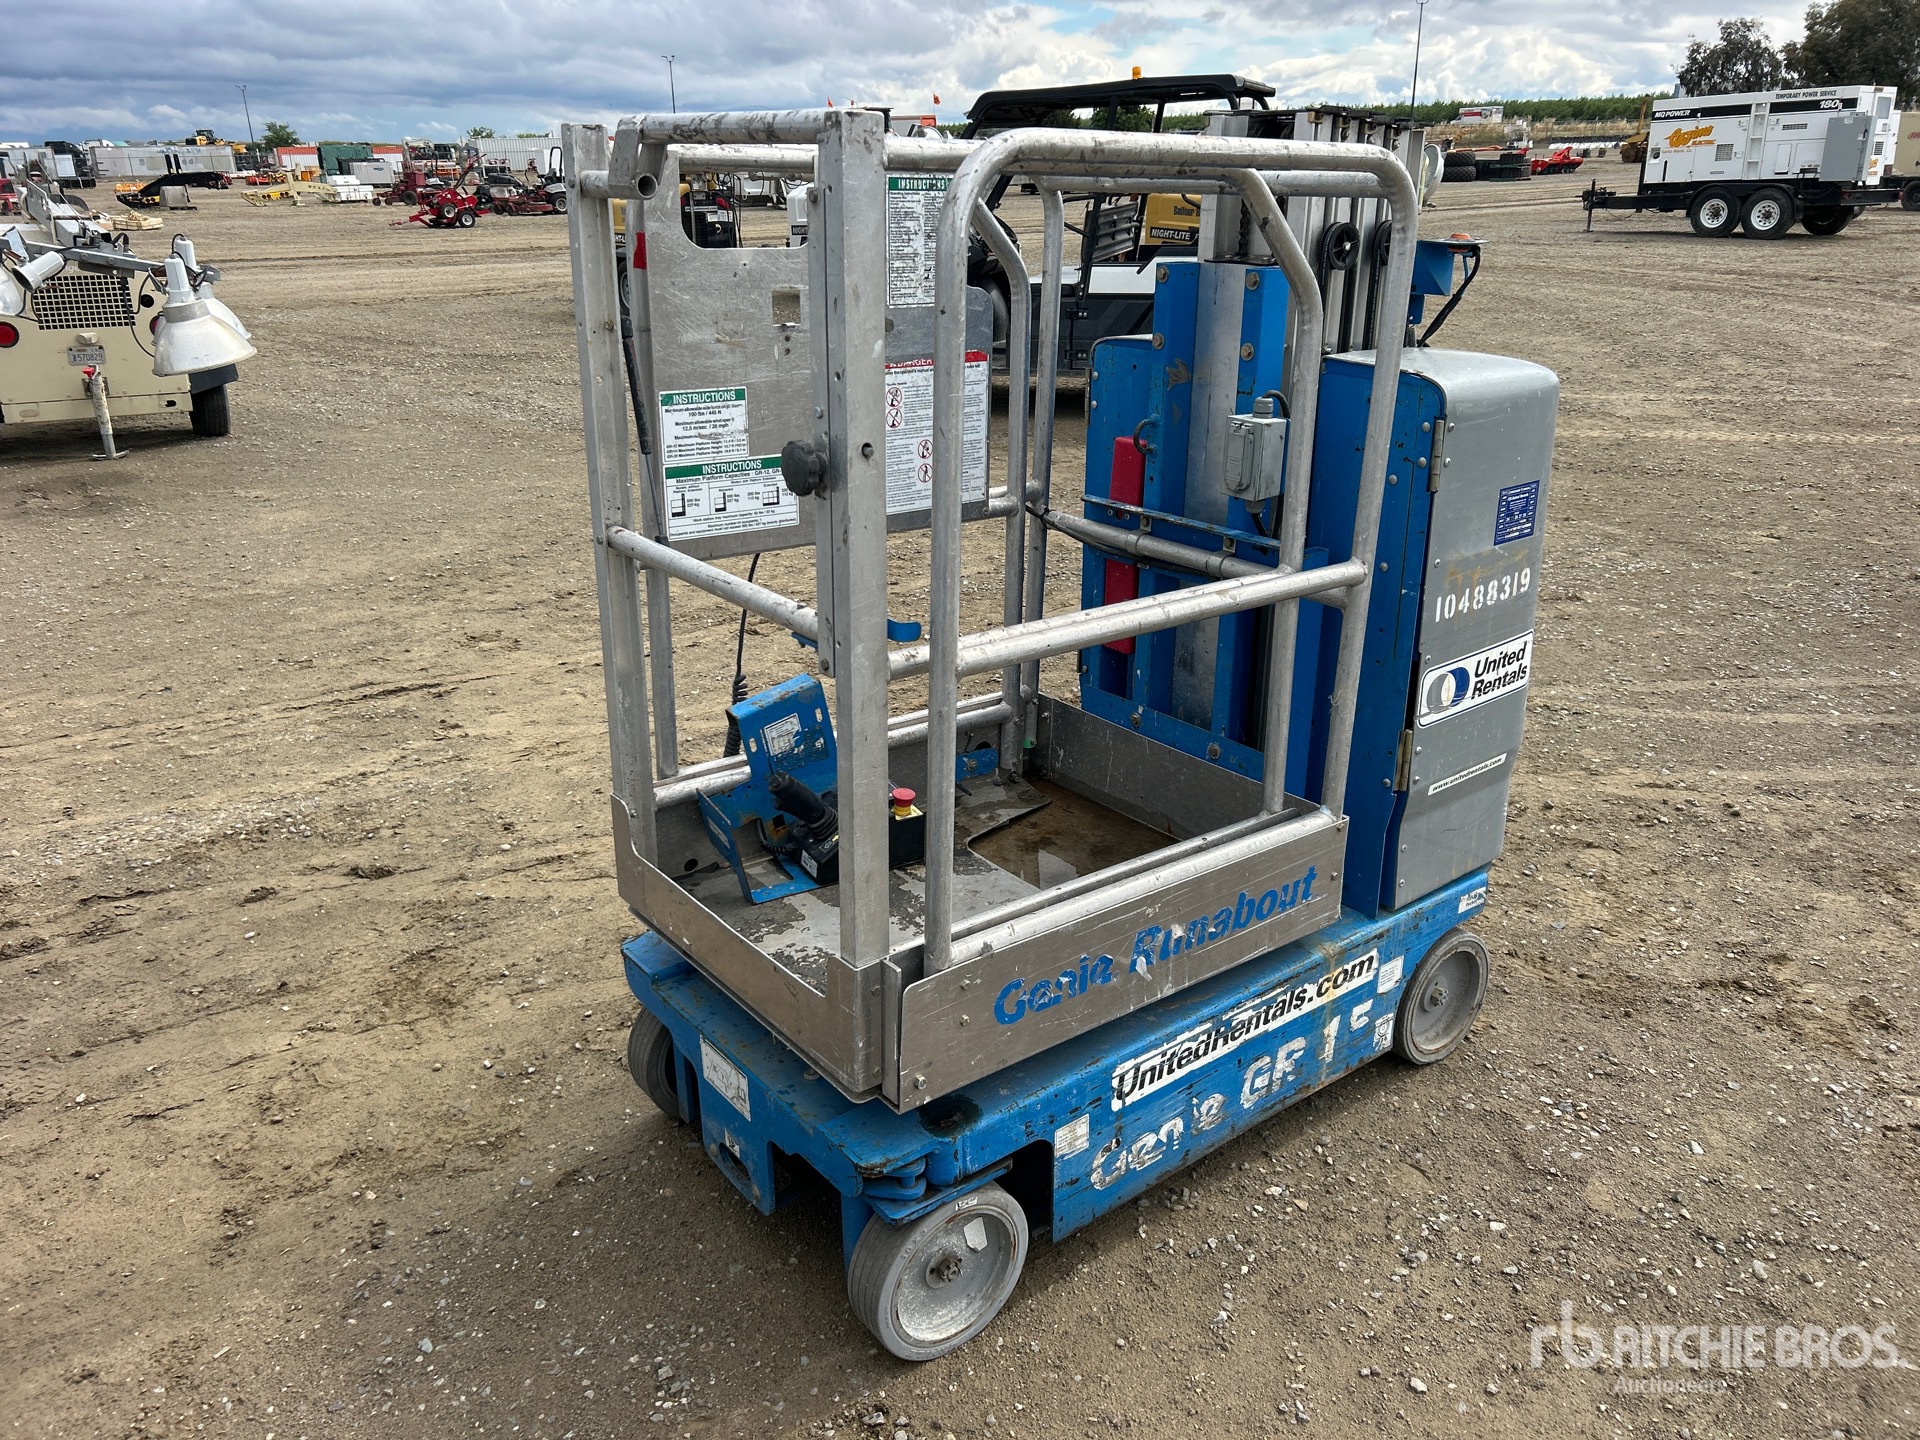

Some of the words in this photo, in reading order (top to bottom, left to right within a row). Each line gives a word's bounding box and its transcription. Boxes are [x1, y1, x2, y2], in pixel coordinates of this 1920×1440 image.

[1152, 229, 1190, 239] NIGHT-LITE
[673, 391, 736, 404] INSTRUCTIONS
[702, 460, 762, 474] INSTRUCTIONS
[725, 472, 750, 480] Capacities
[1436, 568, 1530, 622] 10488319
[1475, 641, 1528, 678] United
[1471, 663, 1528, 699] Rentals
[1433, 758, 1502, 791] www.unitedrentals.com
[994, 954, 1115, 1025] Genie
[1129, 865, 1318, 974] Runabout
[1117, 953, 1375, 1101] UnitedRentals.com
